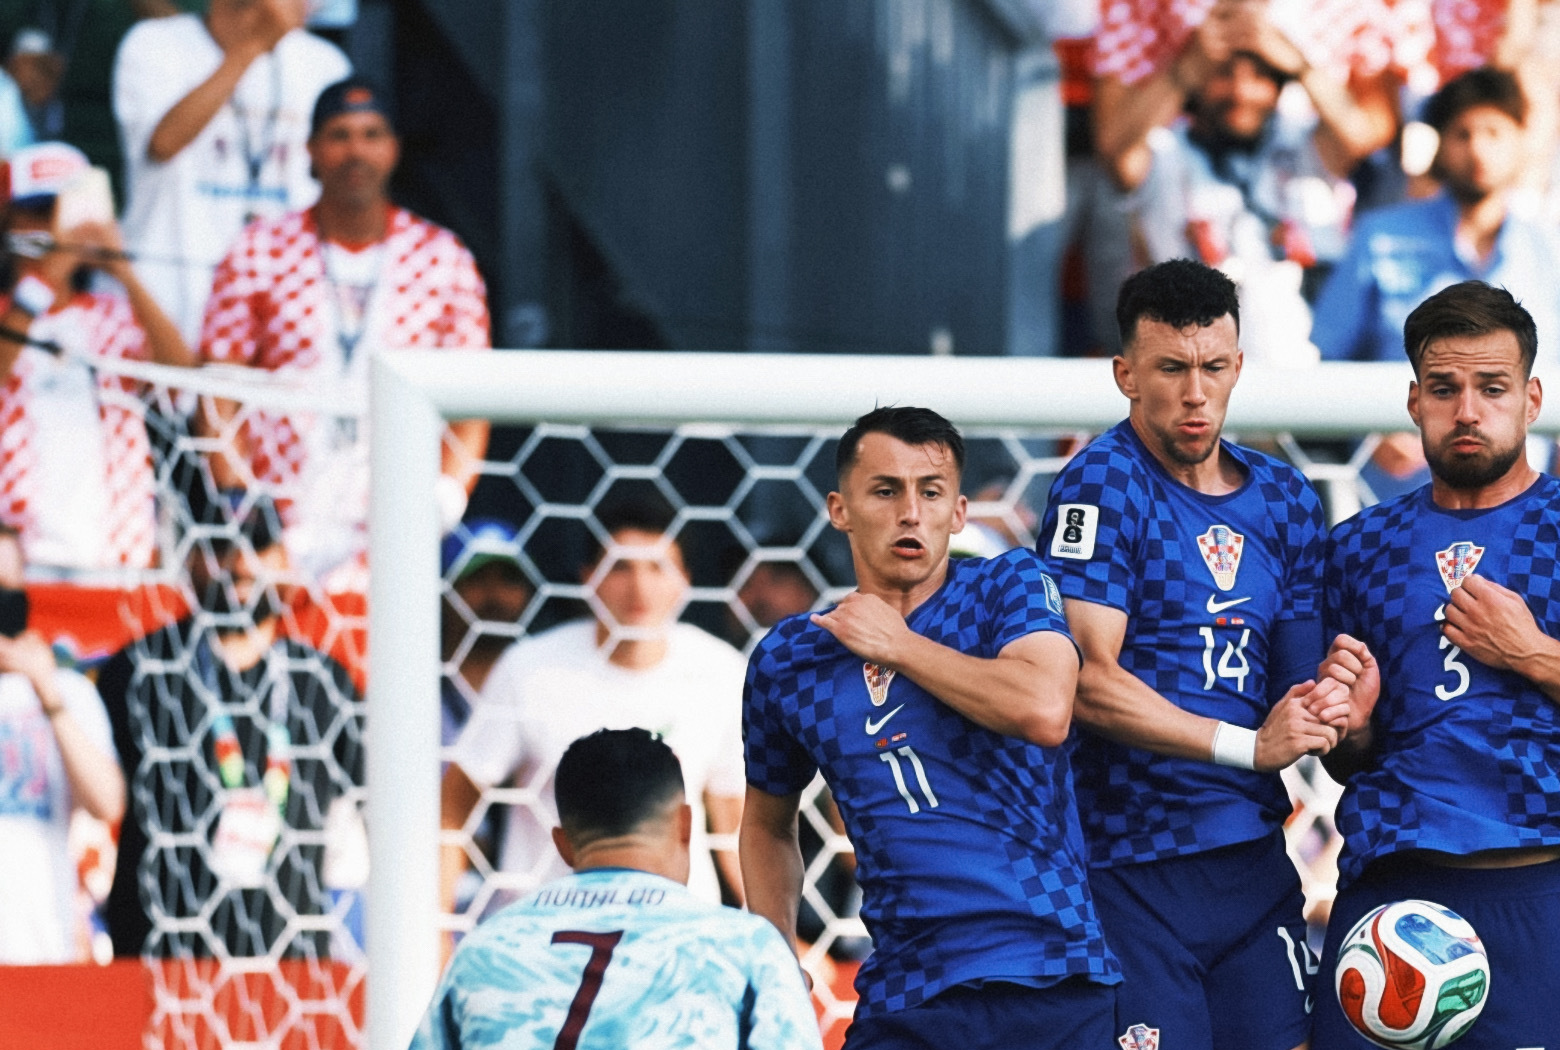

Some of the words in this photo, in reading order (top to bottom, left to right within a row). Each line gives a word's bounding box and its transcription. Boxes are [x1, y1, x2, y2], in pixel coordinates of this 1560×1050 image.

[1198, 626, 1251, 692] 14
[1434, 635, 1471, 702] 3
[879, 745, 939, 814] 11
